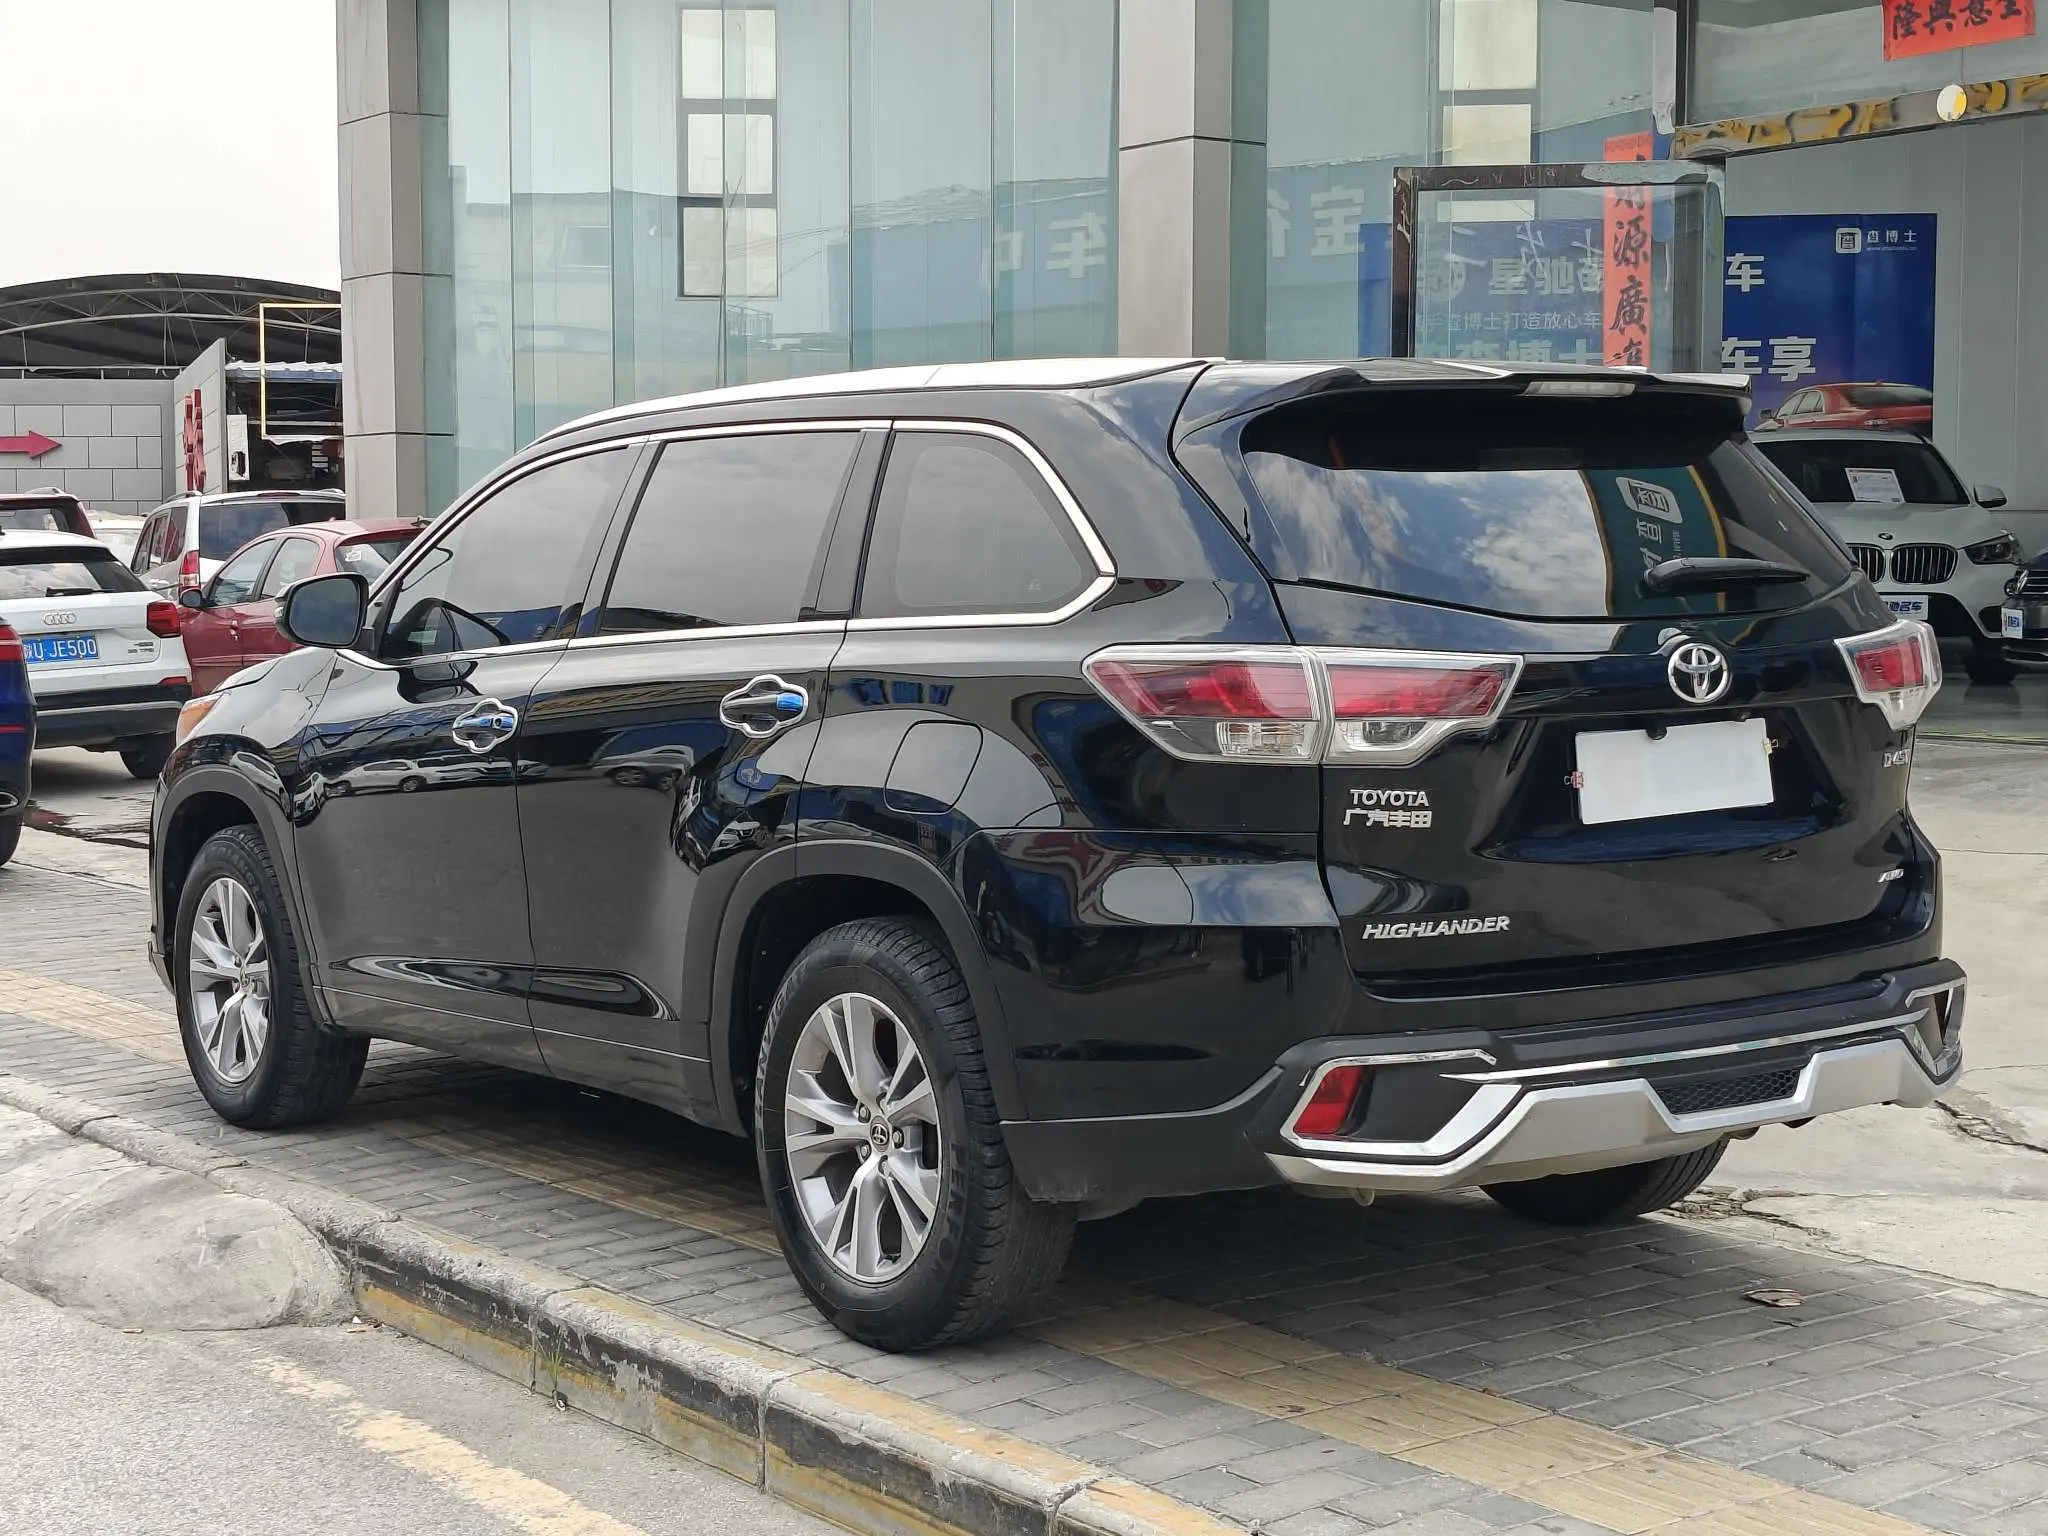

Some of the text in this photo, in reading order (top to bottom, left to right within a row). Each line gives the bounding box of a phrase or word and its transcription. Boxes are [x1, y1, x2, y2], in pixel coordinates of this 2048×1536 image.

[1350, 789, 1430, 807] TOYOTA
[1343, 808, 1432, 828] 广汽丰田
[1362, 915, 1511, 940] HIGHLANDER
